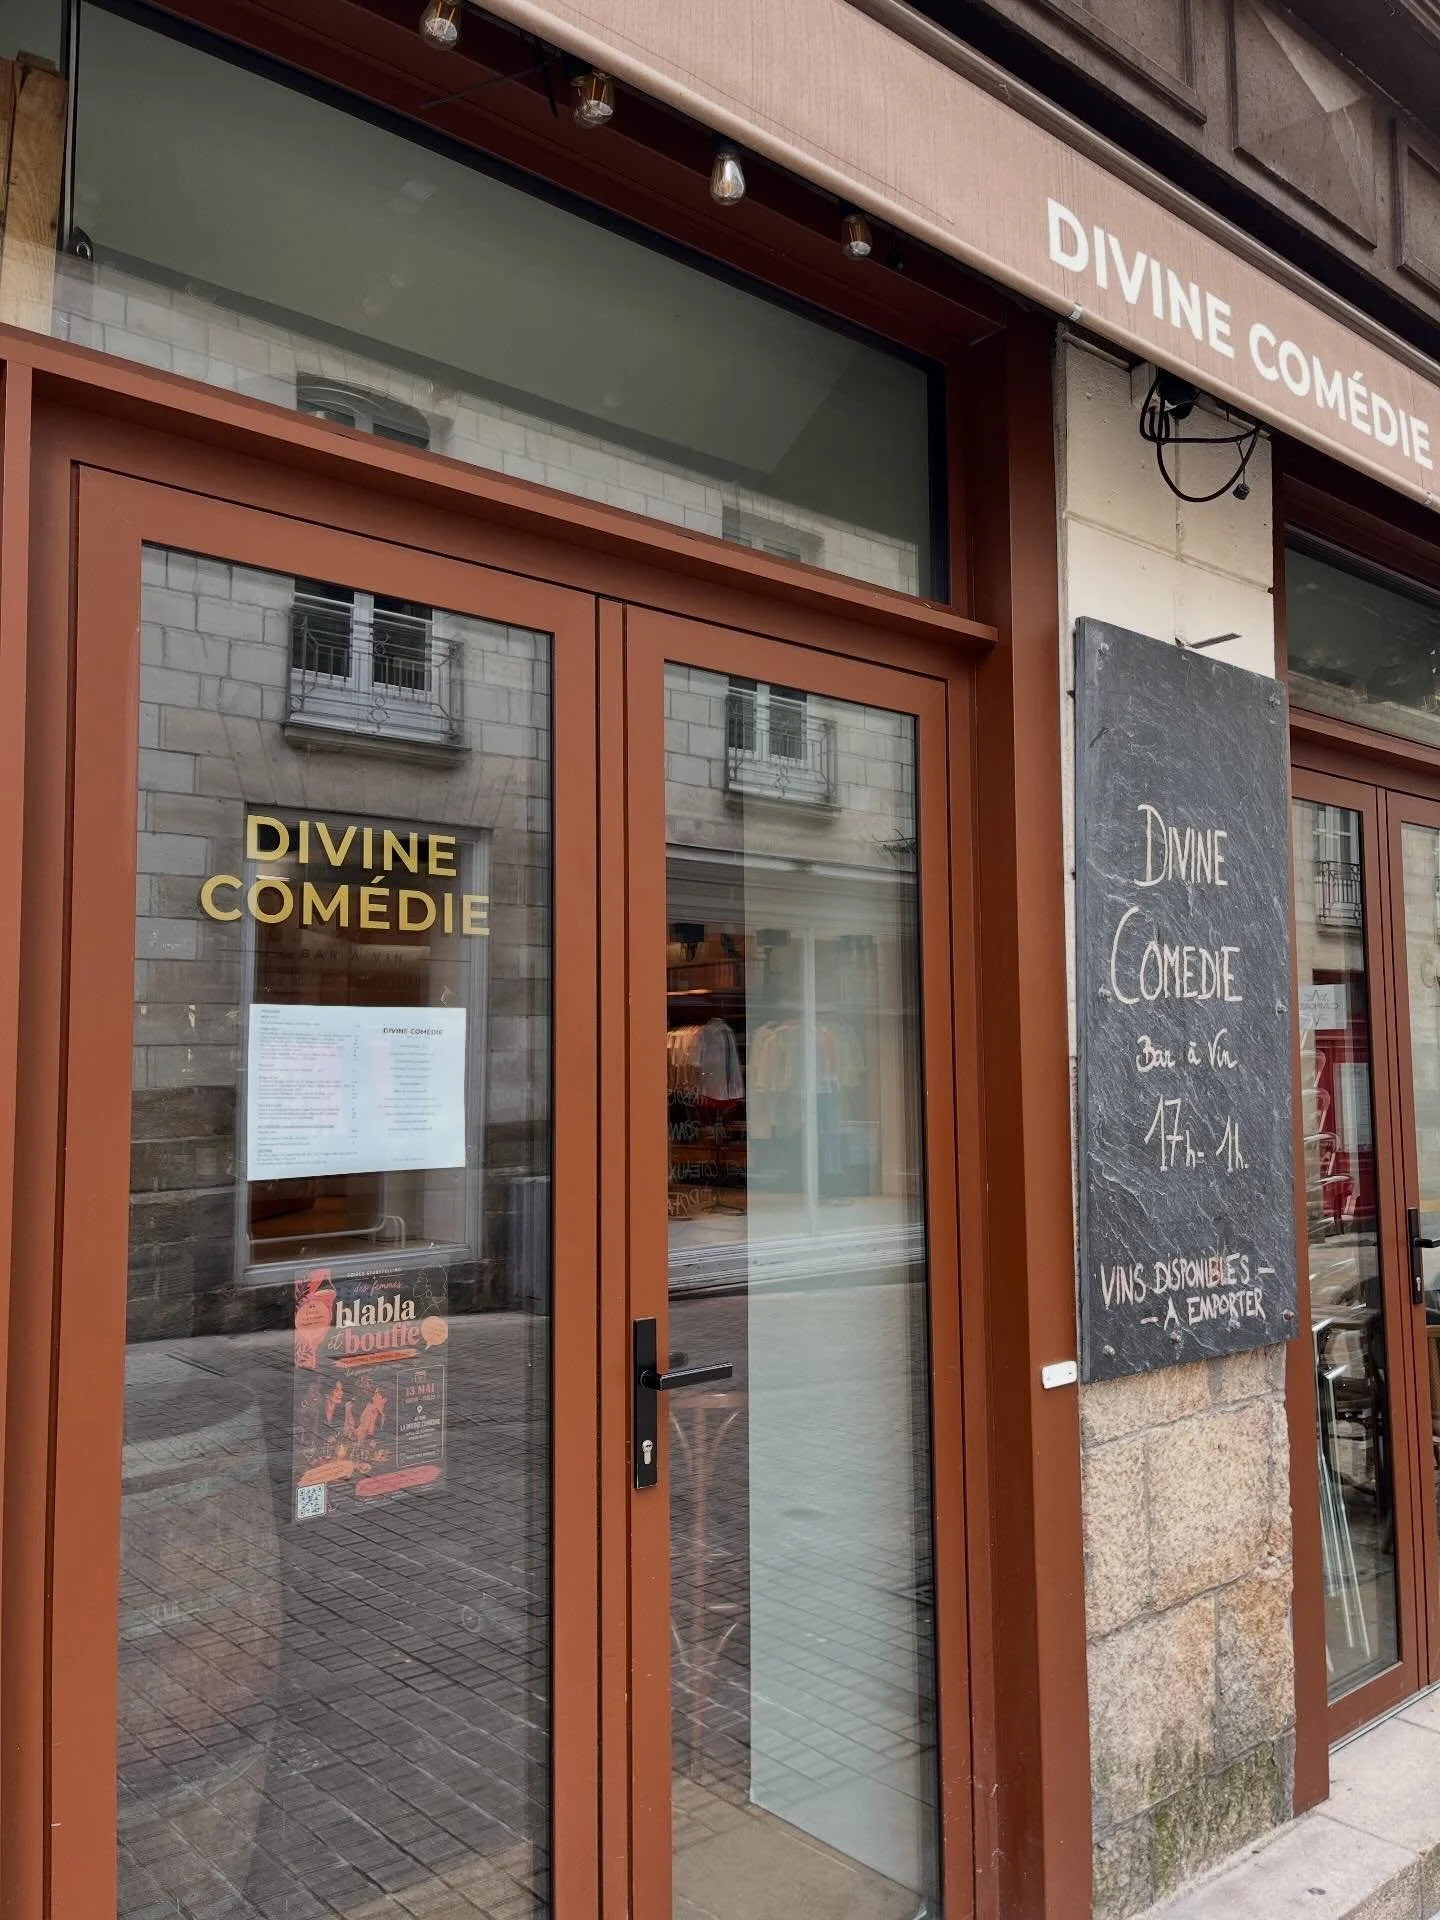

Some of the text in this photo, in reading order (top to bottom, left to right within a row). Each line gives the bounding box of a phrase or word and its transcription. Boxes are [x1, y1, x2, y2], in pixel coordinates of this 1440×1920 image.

[1047, 197, 1433, 470] DIVINE COMÉDIE
[246, 814, 457, 877] DIVINE
[1134, 804, 1228, 886] DIVINE
[200, 875, 490, 936] COMÉDIE
[1110, 905, 1243, 1005] COMEDIE
[1136, 1034, 1176, 1073] Bar
[1208, 1028, 1237, 1069] Vin
[1101, 1263, 1145, 1308] VINS
[1153, 1253, 1249, 1294] DISPONIBLES
[1186, 1288, 1266, 1325] EMPORTER
[327, 1321, 421, 1354] et bouffe
[335, 1294, 417, 1329] blabla
